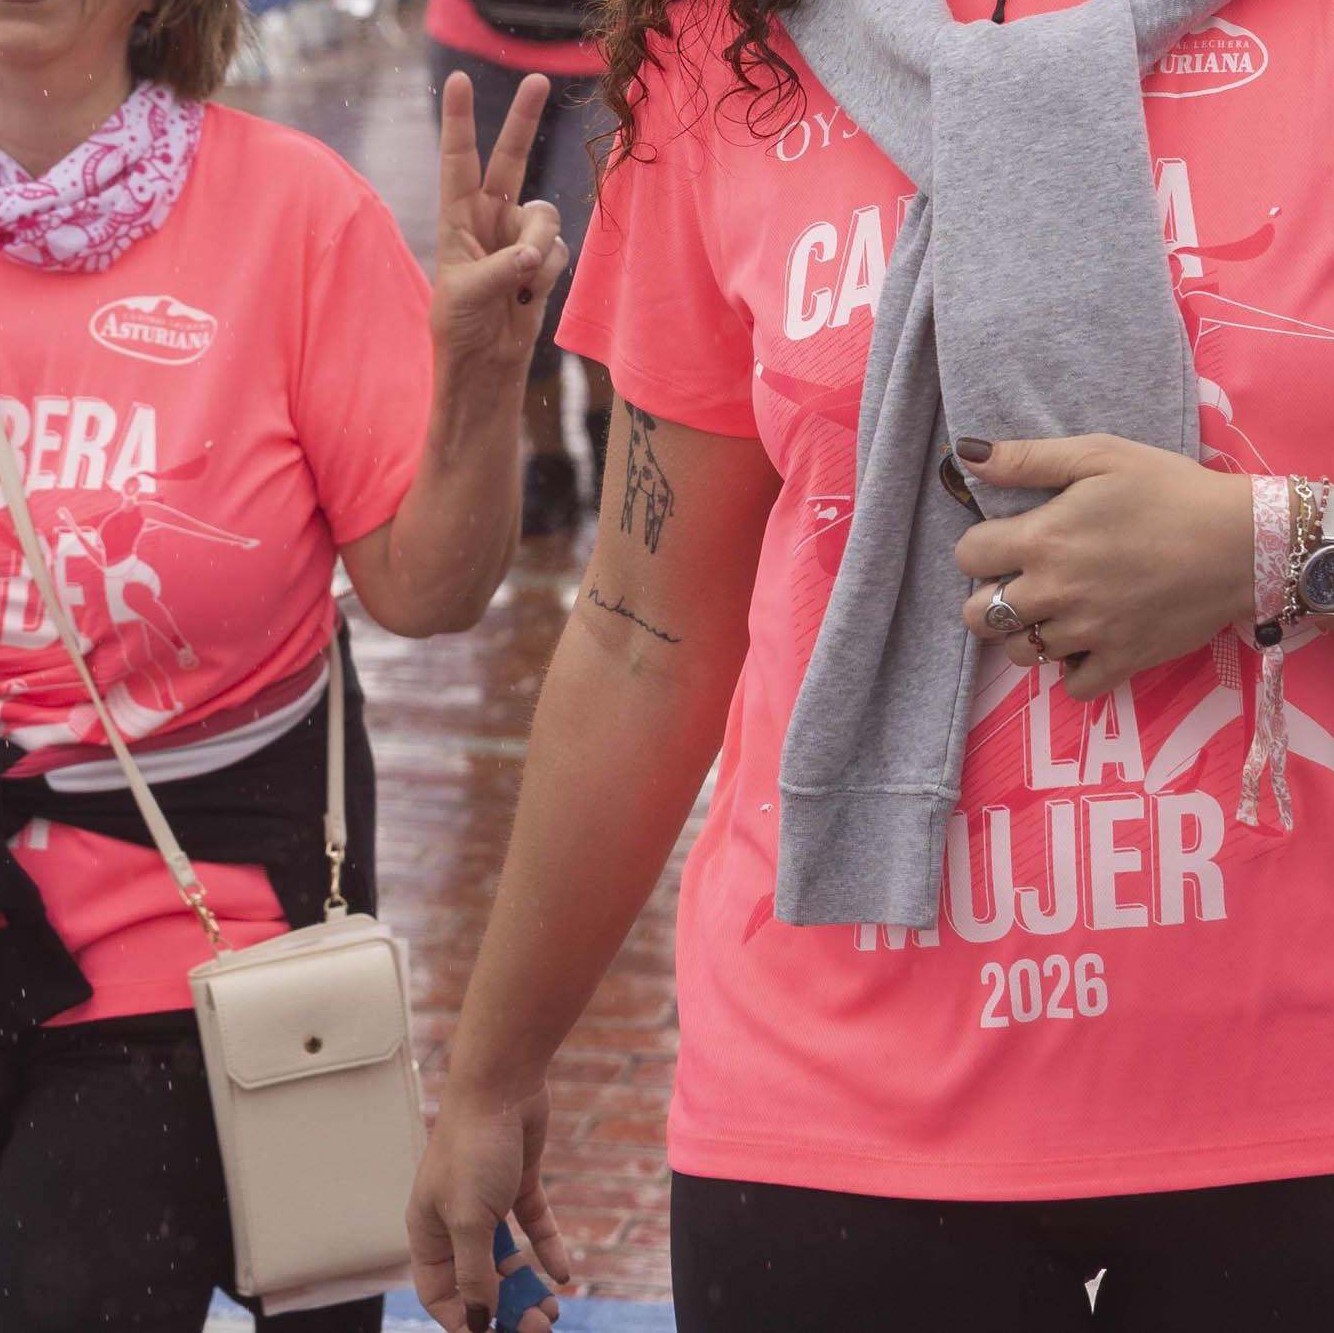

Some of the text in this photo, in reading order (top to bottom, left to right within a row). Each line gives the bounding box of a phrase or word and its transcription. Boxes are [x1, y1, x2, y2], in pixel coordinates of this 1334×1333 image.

[1151, 51, 1255, 75] URIANA
[1194, 39, 1250, 49] LECHERA
[100, 312, 210, 350] ASTURIANA
[852, 788, 1229, 953] UJER
[979, 953, 1109, 1029] 2026
